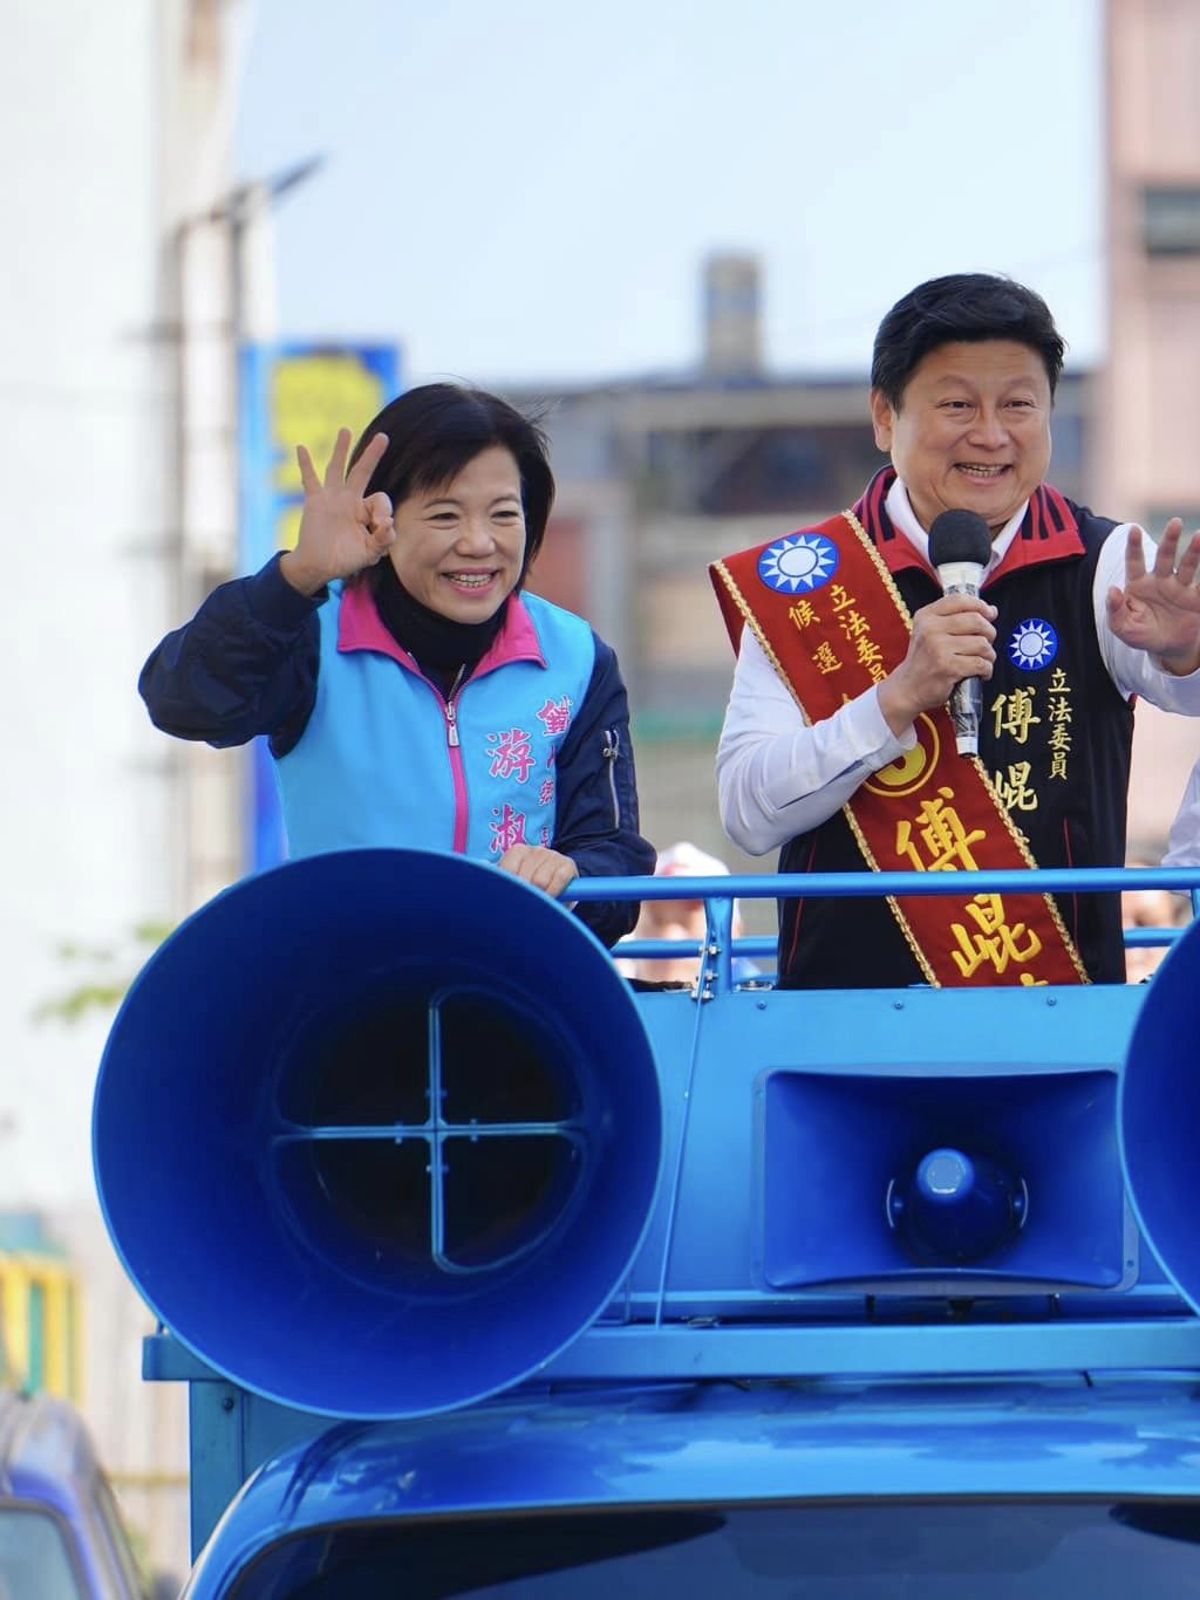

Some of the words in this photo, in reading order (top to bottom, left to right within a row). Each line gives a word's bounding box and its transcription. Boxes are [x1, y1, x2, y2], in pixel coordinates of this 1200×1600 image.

[788, 599, 853, 704] 候選
[1047, 667, 1073, 780] 立法委員
[896, 786, 1049, 986] 傅崐
